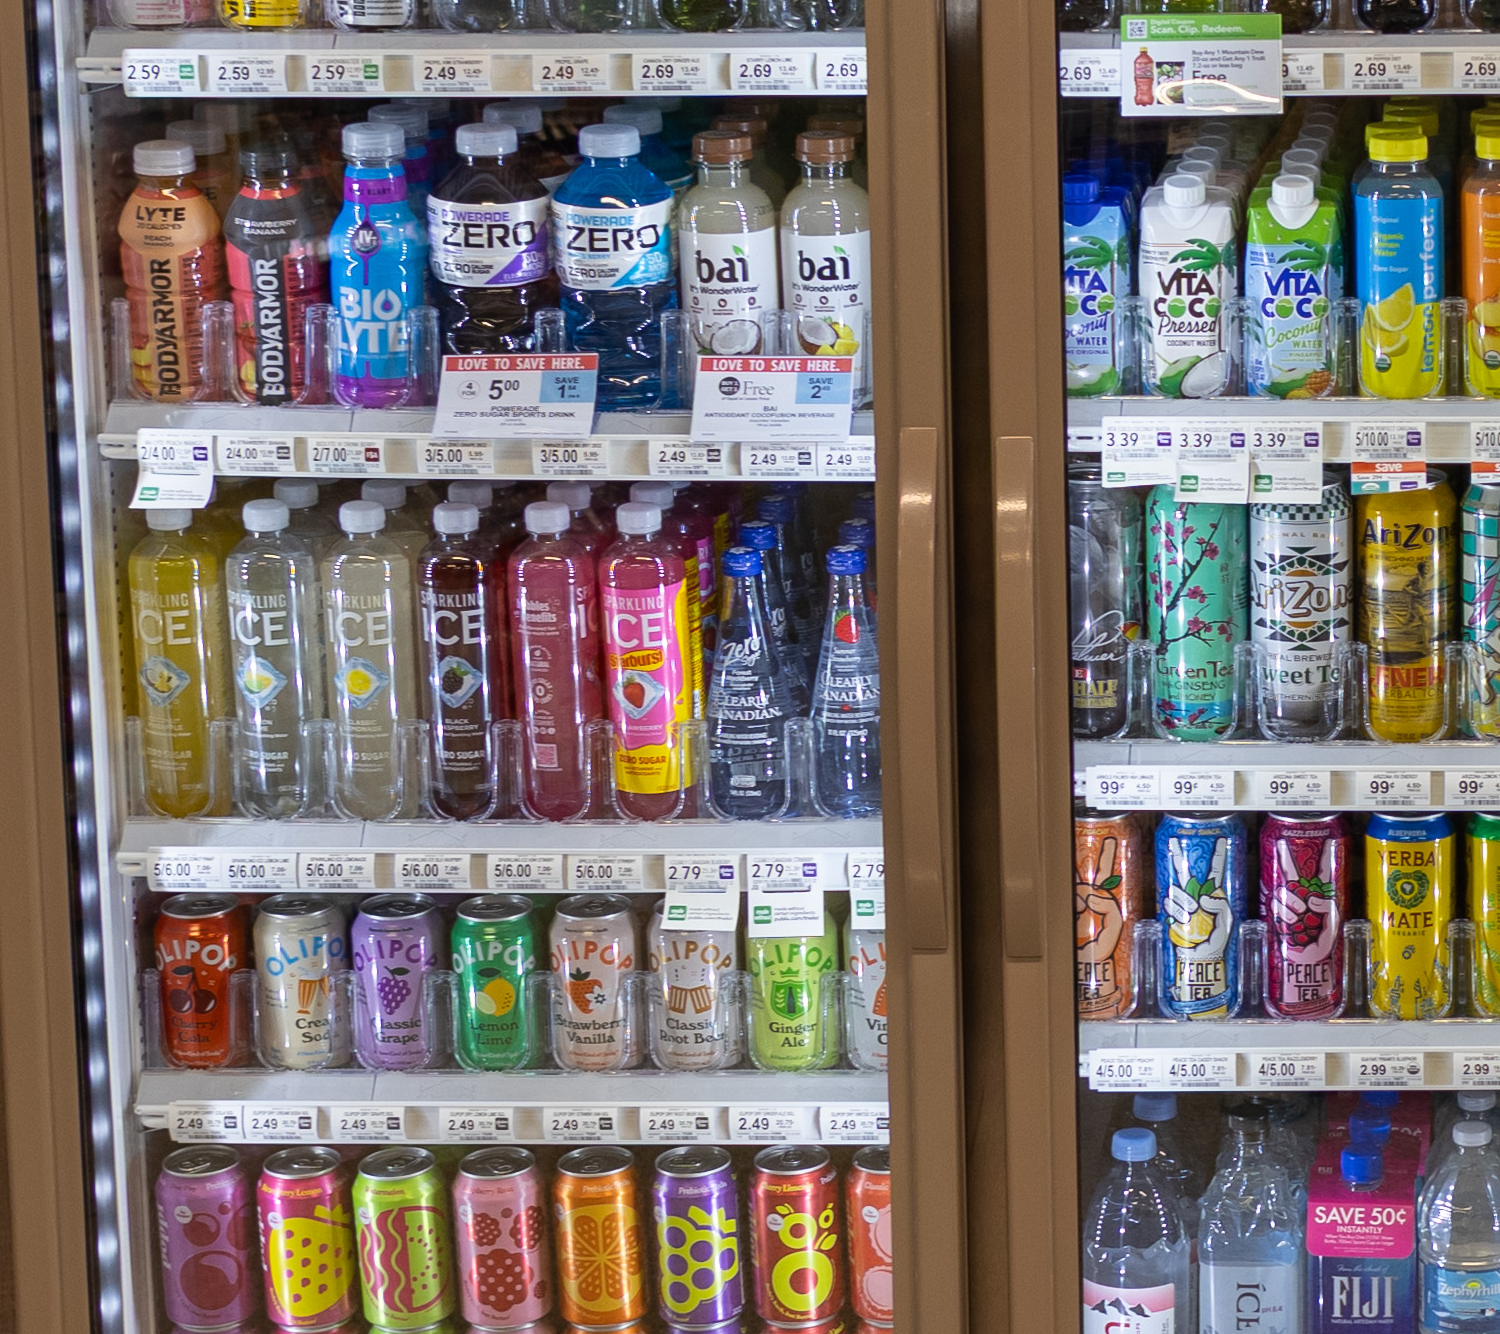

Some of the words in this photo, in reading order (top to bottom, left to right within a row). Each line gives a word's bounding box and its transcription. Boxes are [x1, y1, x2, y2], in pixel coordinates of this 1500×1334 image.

[128, 65, 160, 79] 2.59
[425, 67, 455, 80] 2.49
[642, 65, 673, 78] 2.69
[1355, 63, 1386, 76] 2.69
[136, 206, 185, 222] LYTE
[442, 209, 510, 221] POWERADE
[566, 214, 634, 226] POWERADE
[443, 222, 536, 249] ZERO
[567, 224, 659, 251] ZERO
[696, 245, 749, 283] bai
[799, 245, 851, 281] bai
[1159, 272, 1214, 295] VITA
[1265, 271, 1320, 295] VITA
[340, 288, 400, 319] BIO
[1154, 297, 1220, 318] COCO
[1261, 297, 1328, 318] COCO
[257, 259, 286, 398] BODYARMOR
[1158, 315, 1216, 334] Pressed
[1421, 307, 1435, 373] lemon
[458, 358, 488, 370] LOVE
[495, 358, 510, 370] TO
[517, 358, 546, 370] SAVE
[550, 358, 584, 370] HERE.
[1107, 433, 1138, 446] 3.39
[1356, 432, 1388, 446] 5/10.00
[141, 446, 175, 460] 2/4.00
[313, 448, 346, 461] 2/7.00
[660, 451, 685, 462] 2.49
[827, 454, 851, 465] 2.49
[1374, 461, 1403, 473] save
[606, 612, 663, 646] ICE
[1377, 851, 1435, 866] YERBA
[307, 864, 342, 876] 5/6.00
[577, 866, 612, 878] 5/6.00
[752, 864, 783, 877] 2.79
[1383, 911, 1433, 927] MATE
[155, 940, 237, 972] OLIPOP
[551, 941, 633, 972] OLIPOP
[1287, 963, 1328, 983] PEACE
[1297, 986, 1319, 1001] TEA
[769, 1021, 817, 1034] Ginger
[567, 1031, 615, 1044] Vanilla
[781, 1036, 805, 1048] Ale
[1259, 1063, 1295, 1076] 4/5.00
[341, 1120, 366, 1130] 2.49
[553, 1120, 578, 1130] 2.49
[831, 1120, 855, 1129] 2.49
[1315, 1207, 1367, 1225] SAVE
[1371, 1208, 1407, 1226] 50¢
[1337, 1225, 1382, 1234] INSTANTLY
[1331, 1276, 1393, 1318] FIJI
